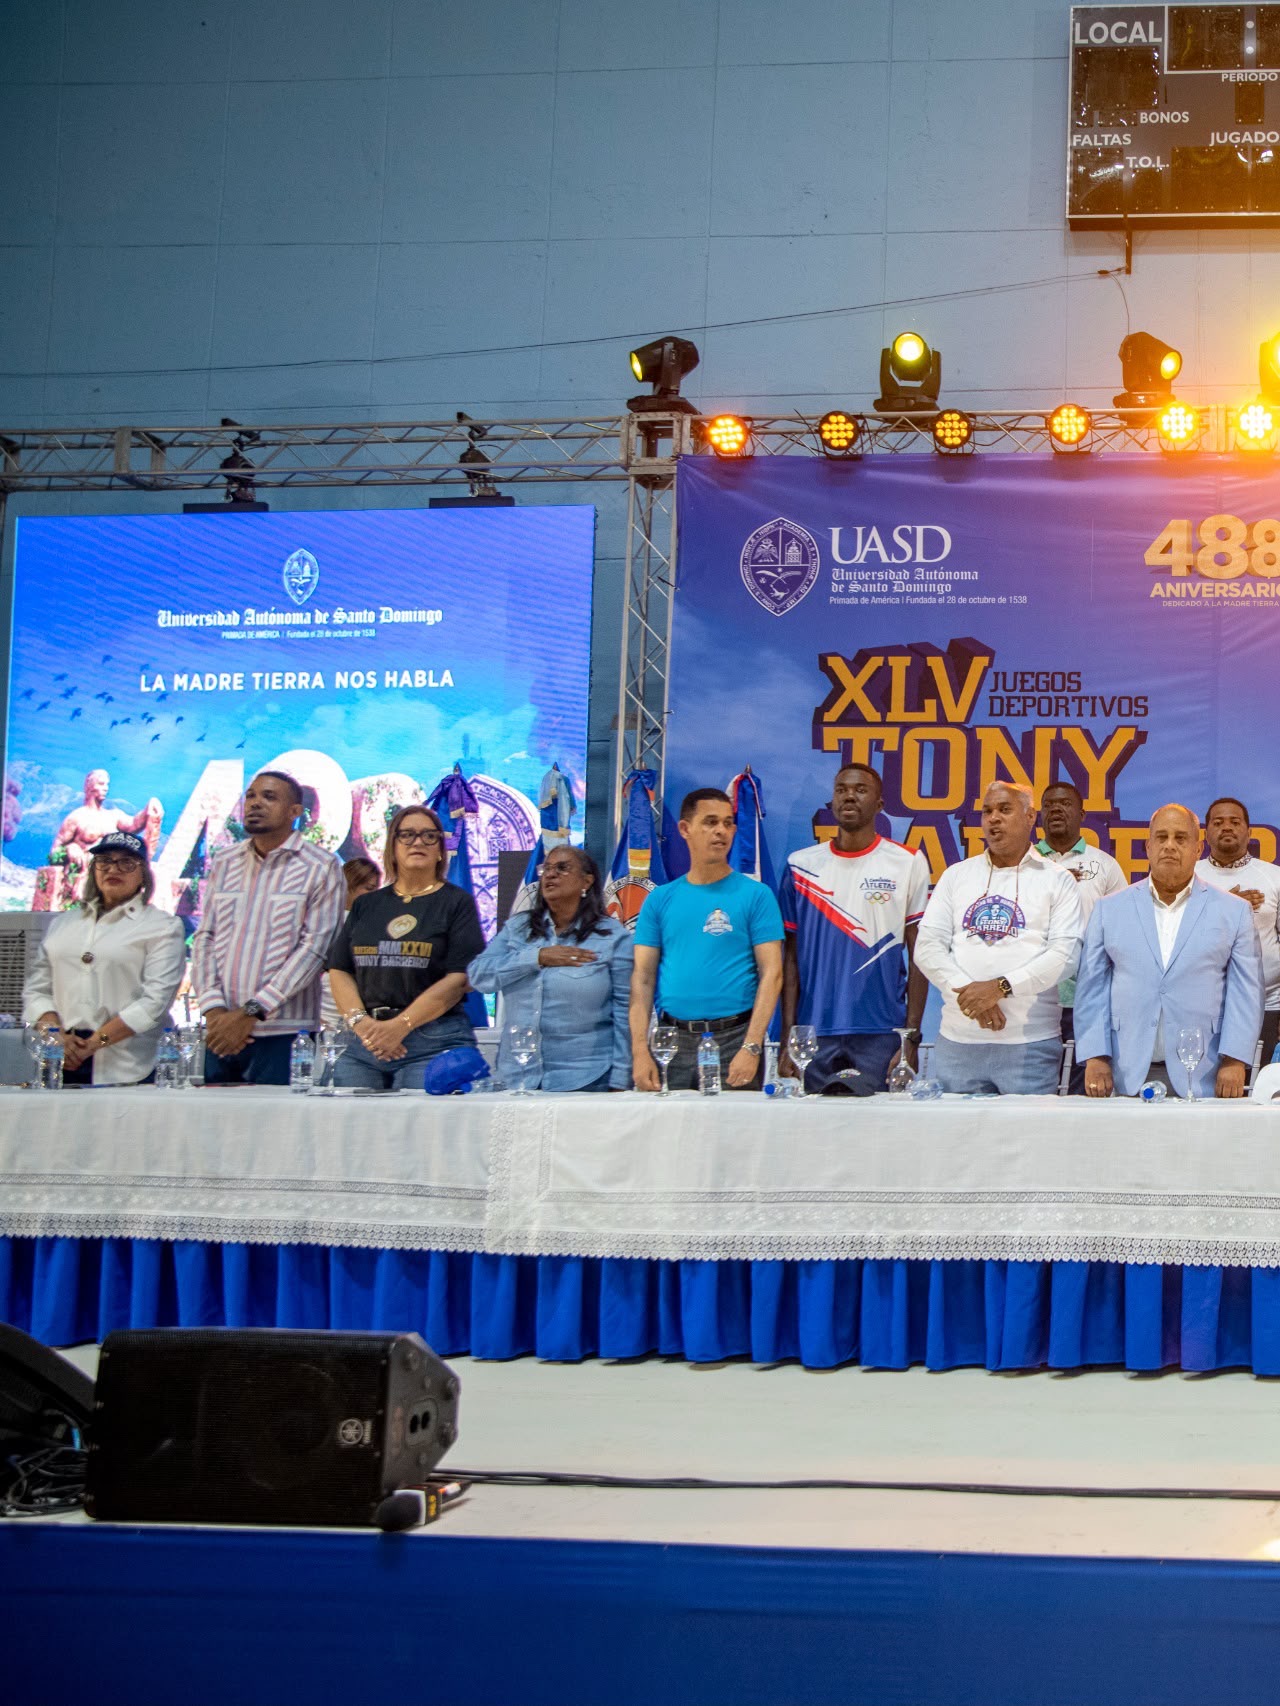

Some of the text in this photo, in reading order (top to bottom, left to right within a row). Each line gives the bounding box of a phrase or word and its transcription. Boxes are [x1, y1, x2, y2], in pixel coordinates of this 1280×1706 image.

[1075, 21, 1162, 44] LOCAL
[1221, 72, 1278, 82] PERIODO
[1140, 112, 1190, 124] BONOS
[1073, 134, 1132, 146] FALTAS
[1126, 156, 1170, 169] T.O.L.
[828, 525, 952, 564] UASD
[832, 567, 979, 581] Universidad Autónoma
[831, 581, 952, 595] de Santo Domingo
[829, 596, 858, 605] Primada
[860, 596, 869, 605] de
[871, 595, 900, 604] América
[906, 596, 936, 604] Fundada
[946, 595, 956, 604] 28
[958, 595, 967, 604] de
[969, 595, 996, 604] octubre
[997, 595, 1007, 604] de
[1009, 595, 1027, 604] 1538
[158, 606, 443, 627] Universidad Autónoma de Santo Domingo
[140, 669, 455, 692] LA MADRE TIERRA NOS HABLA
[989, 671, 1082, 693] JUEGOS
[823, 656, 990, 723] XLV
[988, 696, 1149, 717] DEPORTIVOS
[823, 727, 1138, 812] TONY
[107, 832, 141, 849] UASD
[859, 877, 896, 890] ATLETAS
